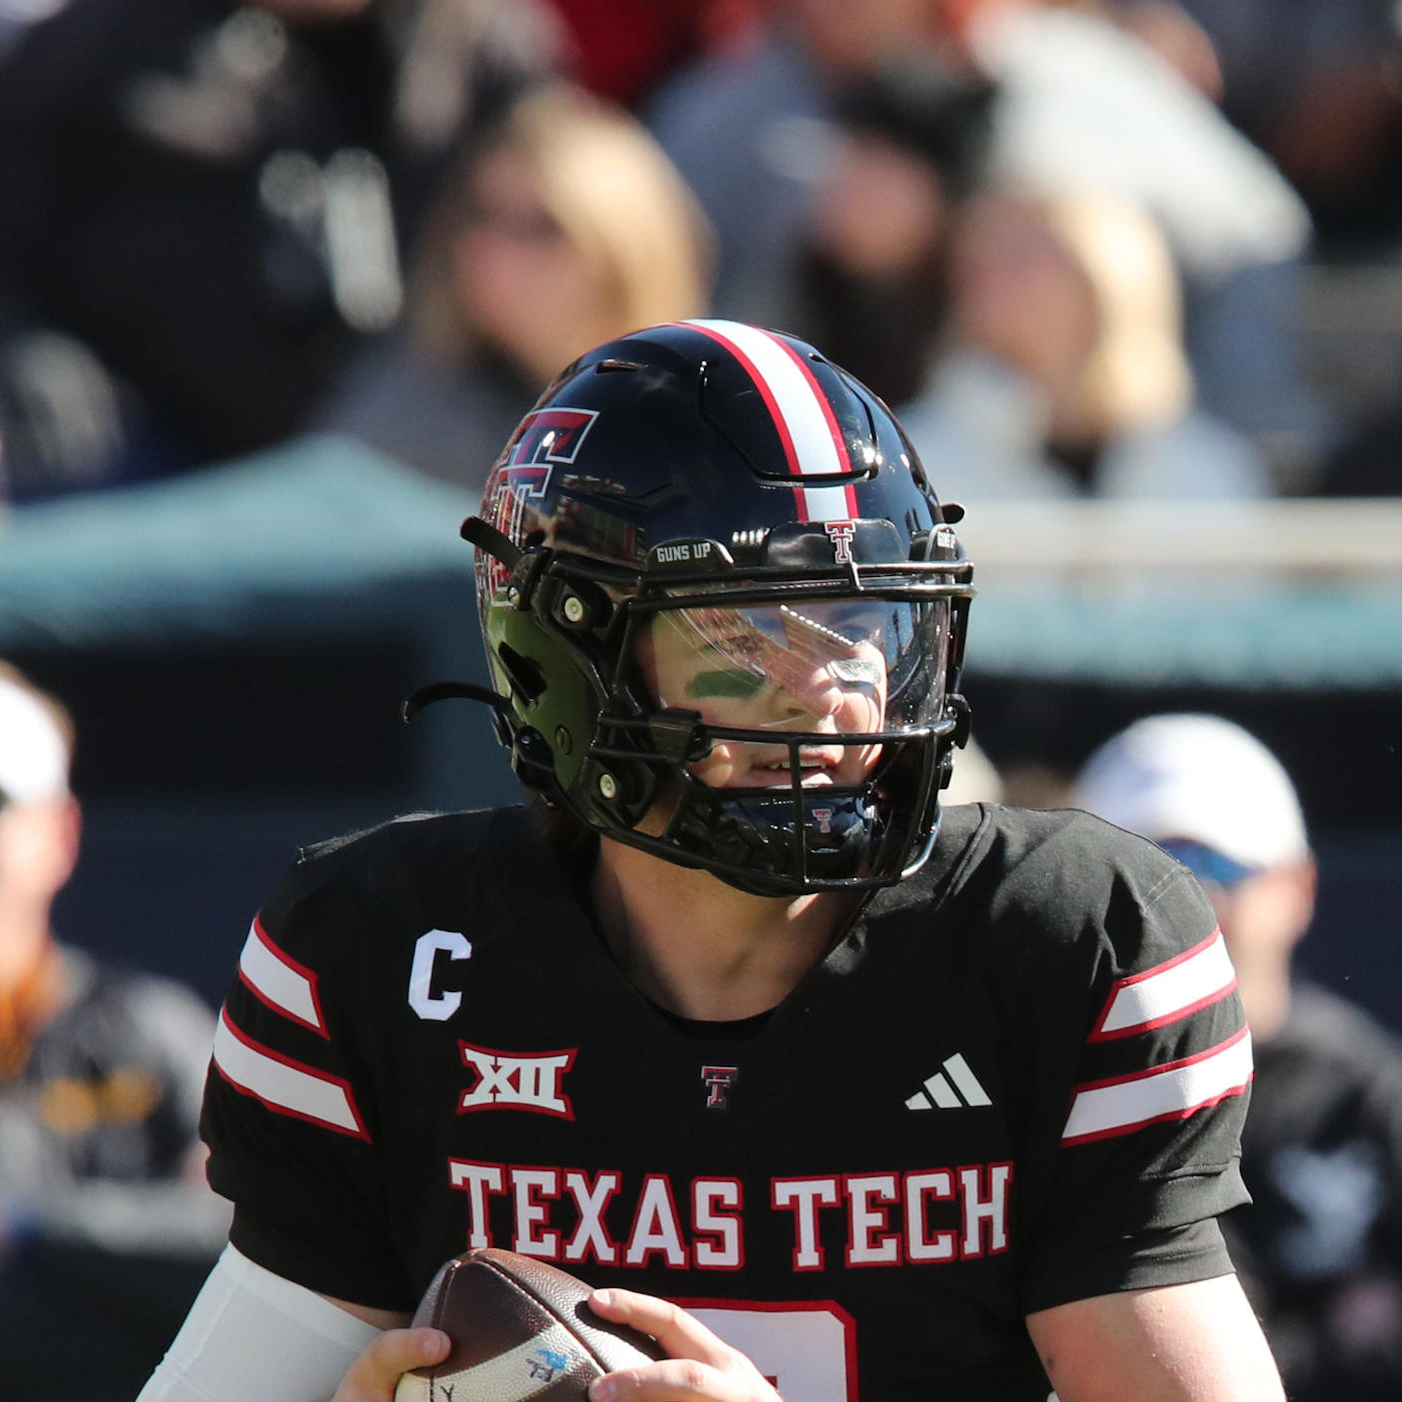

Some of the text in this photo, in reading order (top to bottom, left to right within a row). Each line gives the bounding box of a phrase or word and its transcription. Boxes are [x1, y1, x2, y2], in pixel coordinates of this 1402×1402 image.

[656, 542, 712, 563] GUNS UP
[408, 928, 472, 1021] C
[458, 1041, 577, 1121] XII
[447, 1156, 1014, 1272] TEXAS TECH
